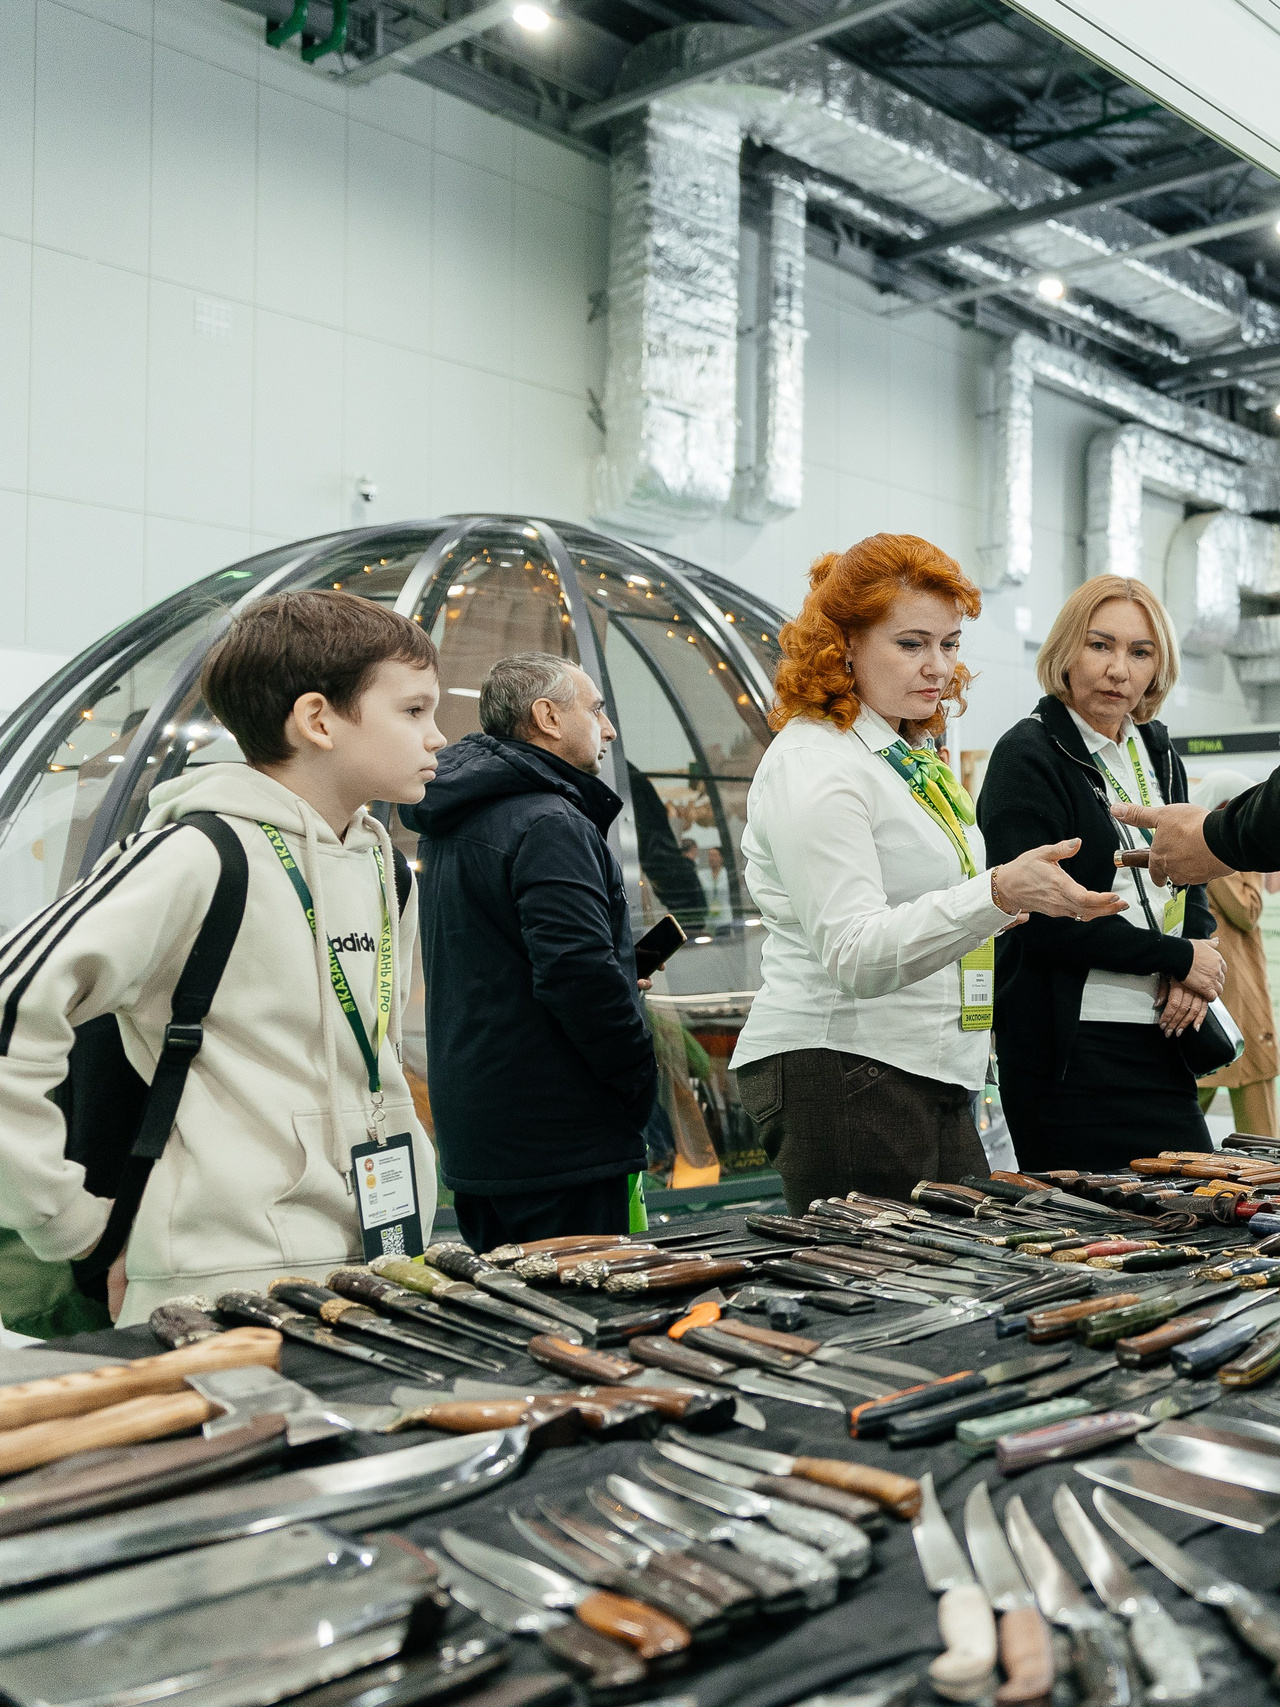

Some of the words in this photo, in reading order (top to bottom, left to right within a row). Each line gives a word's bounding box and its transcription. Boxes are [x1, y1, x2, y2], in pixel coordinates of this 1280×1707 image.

[1134, 767, 1150, 799] КАЗАНЬ
[380, 928, 392, 978] КАЗАНЬ
[380, 980, 391, 1013] АГРО
